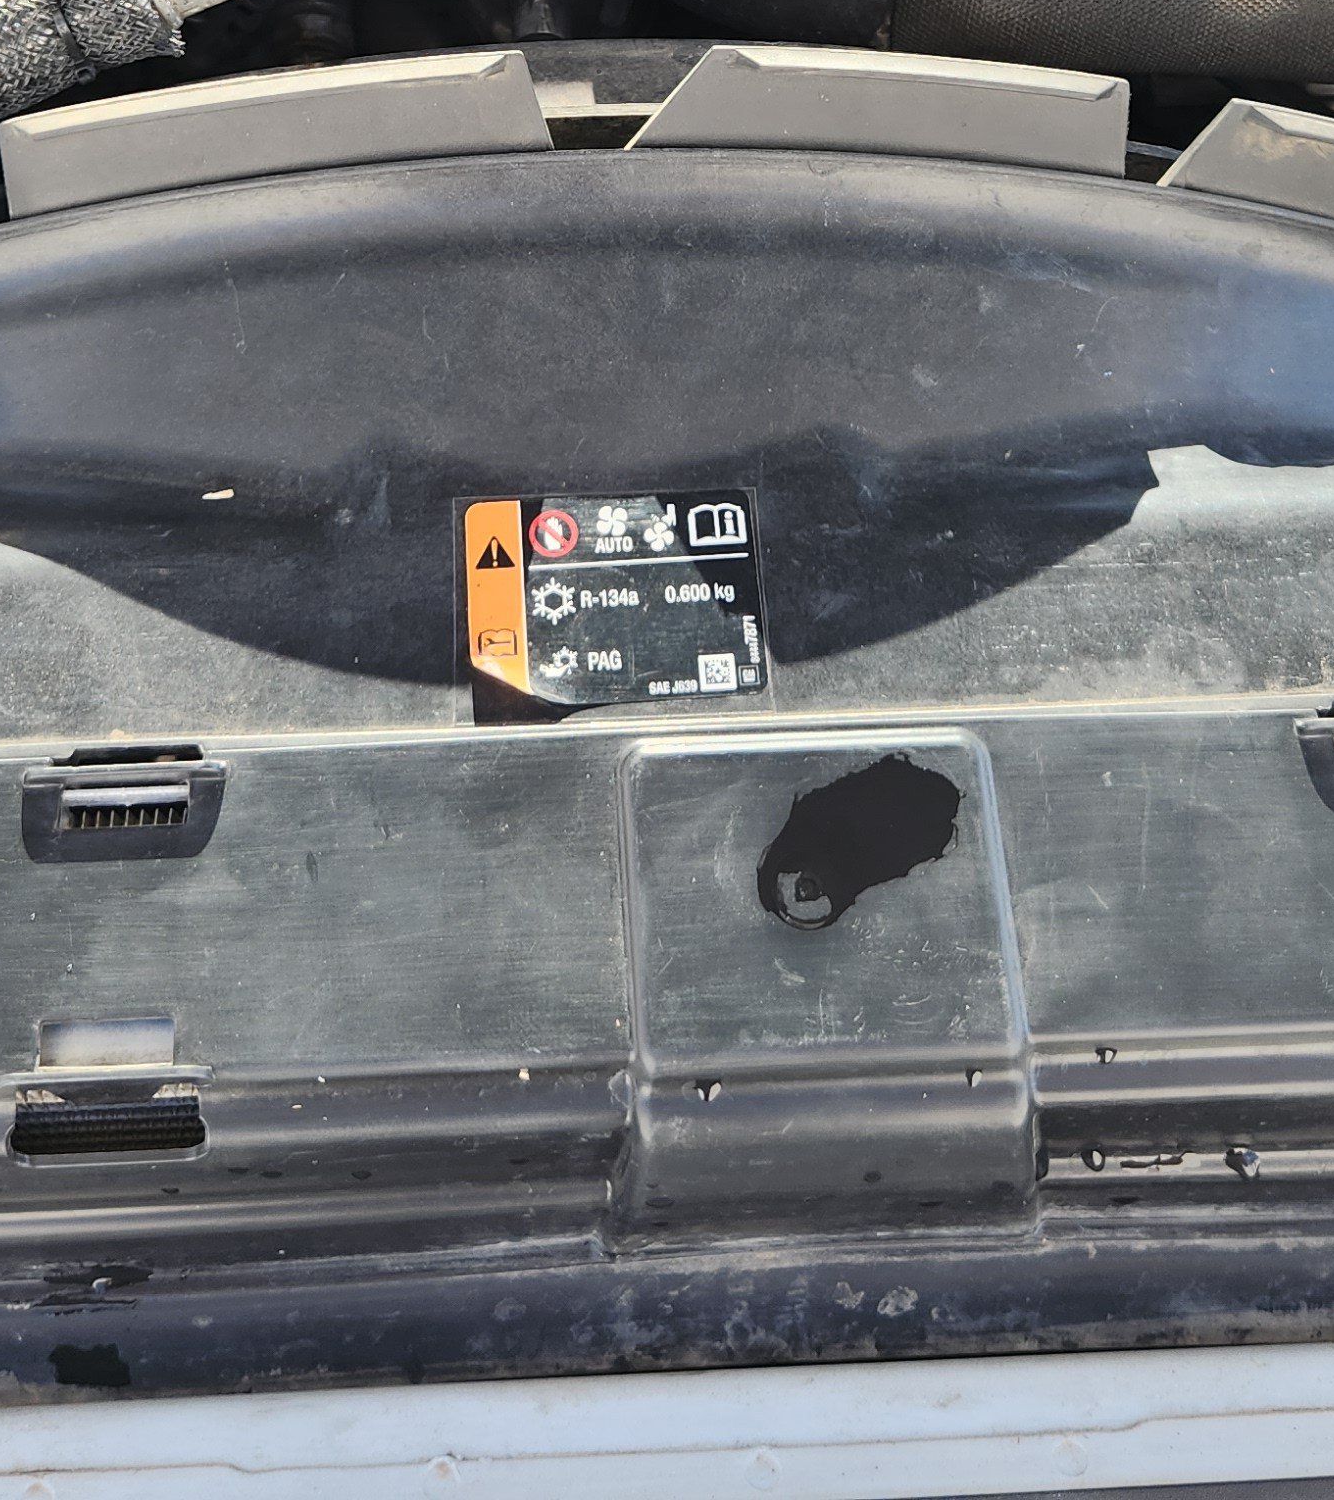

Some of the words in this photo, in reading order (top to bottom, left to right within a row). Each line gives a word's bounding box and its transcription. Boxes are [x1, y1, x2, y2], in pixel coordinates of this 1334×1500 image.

[595, 535, 633, 553] AUTO
[580, 588, 640, 609] R-134a
[665, 583, 710, 603] 0.600
[714, 583, 735, 602] kg
[587, 650, 622, 672] PAG
[648, 680, 671, 695] SAE
[671, 679, 698, 694] J639
